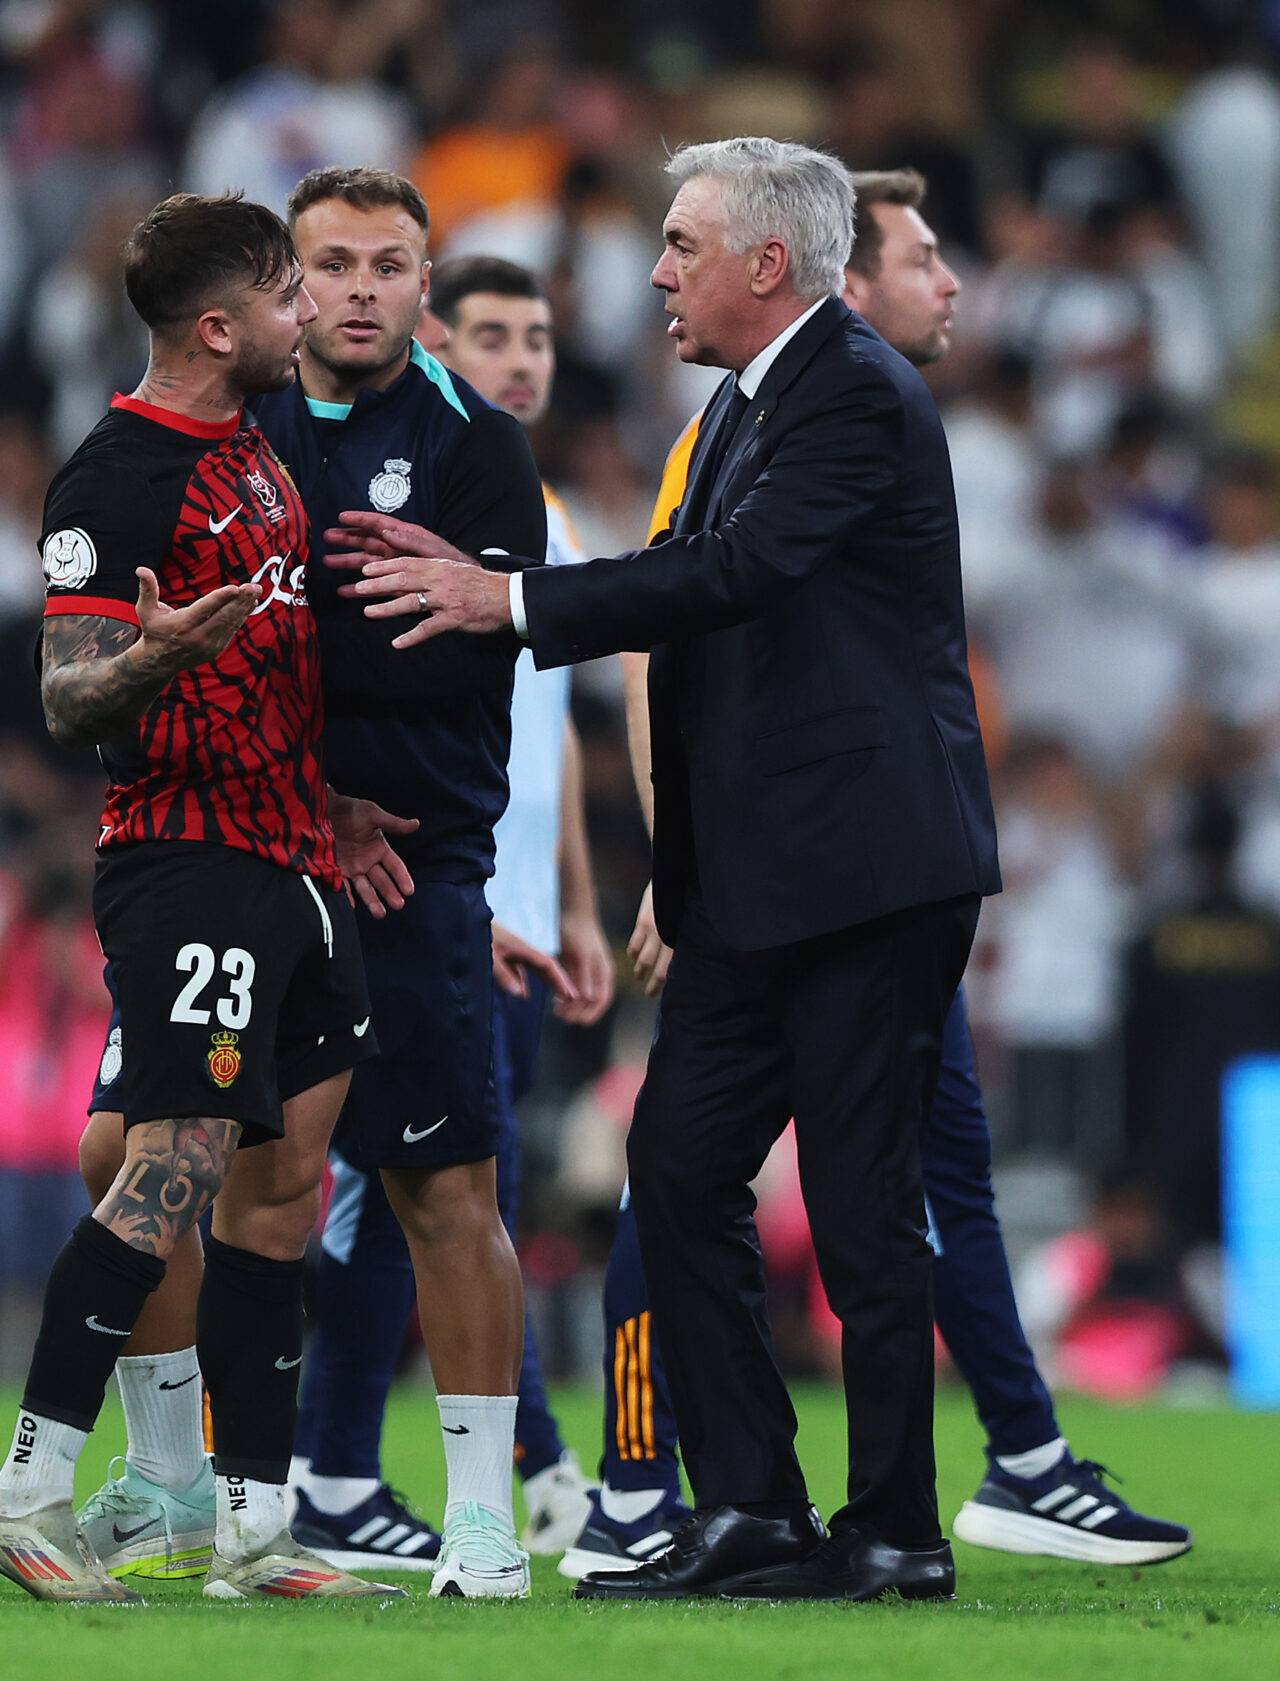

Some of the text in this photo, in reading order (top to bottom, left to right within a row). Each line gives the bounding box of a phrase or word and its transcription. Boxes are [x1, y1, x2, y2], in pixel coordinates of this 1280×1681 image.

[170, 942, 256, 1030] 23
[13, 1416, 37, 1464] NEO
[226, 1474, 247, 1511] NEO
